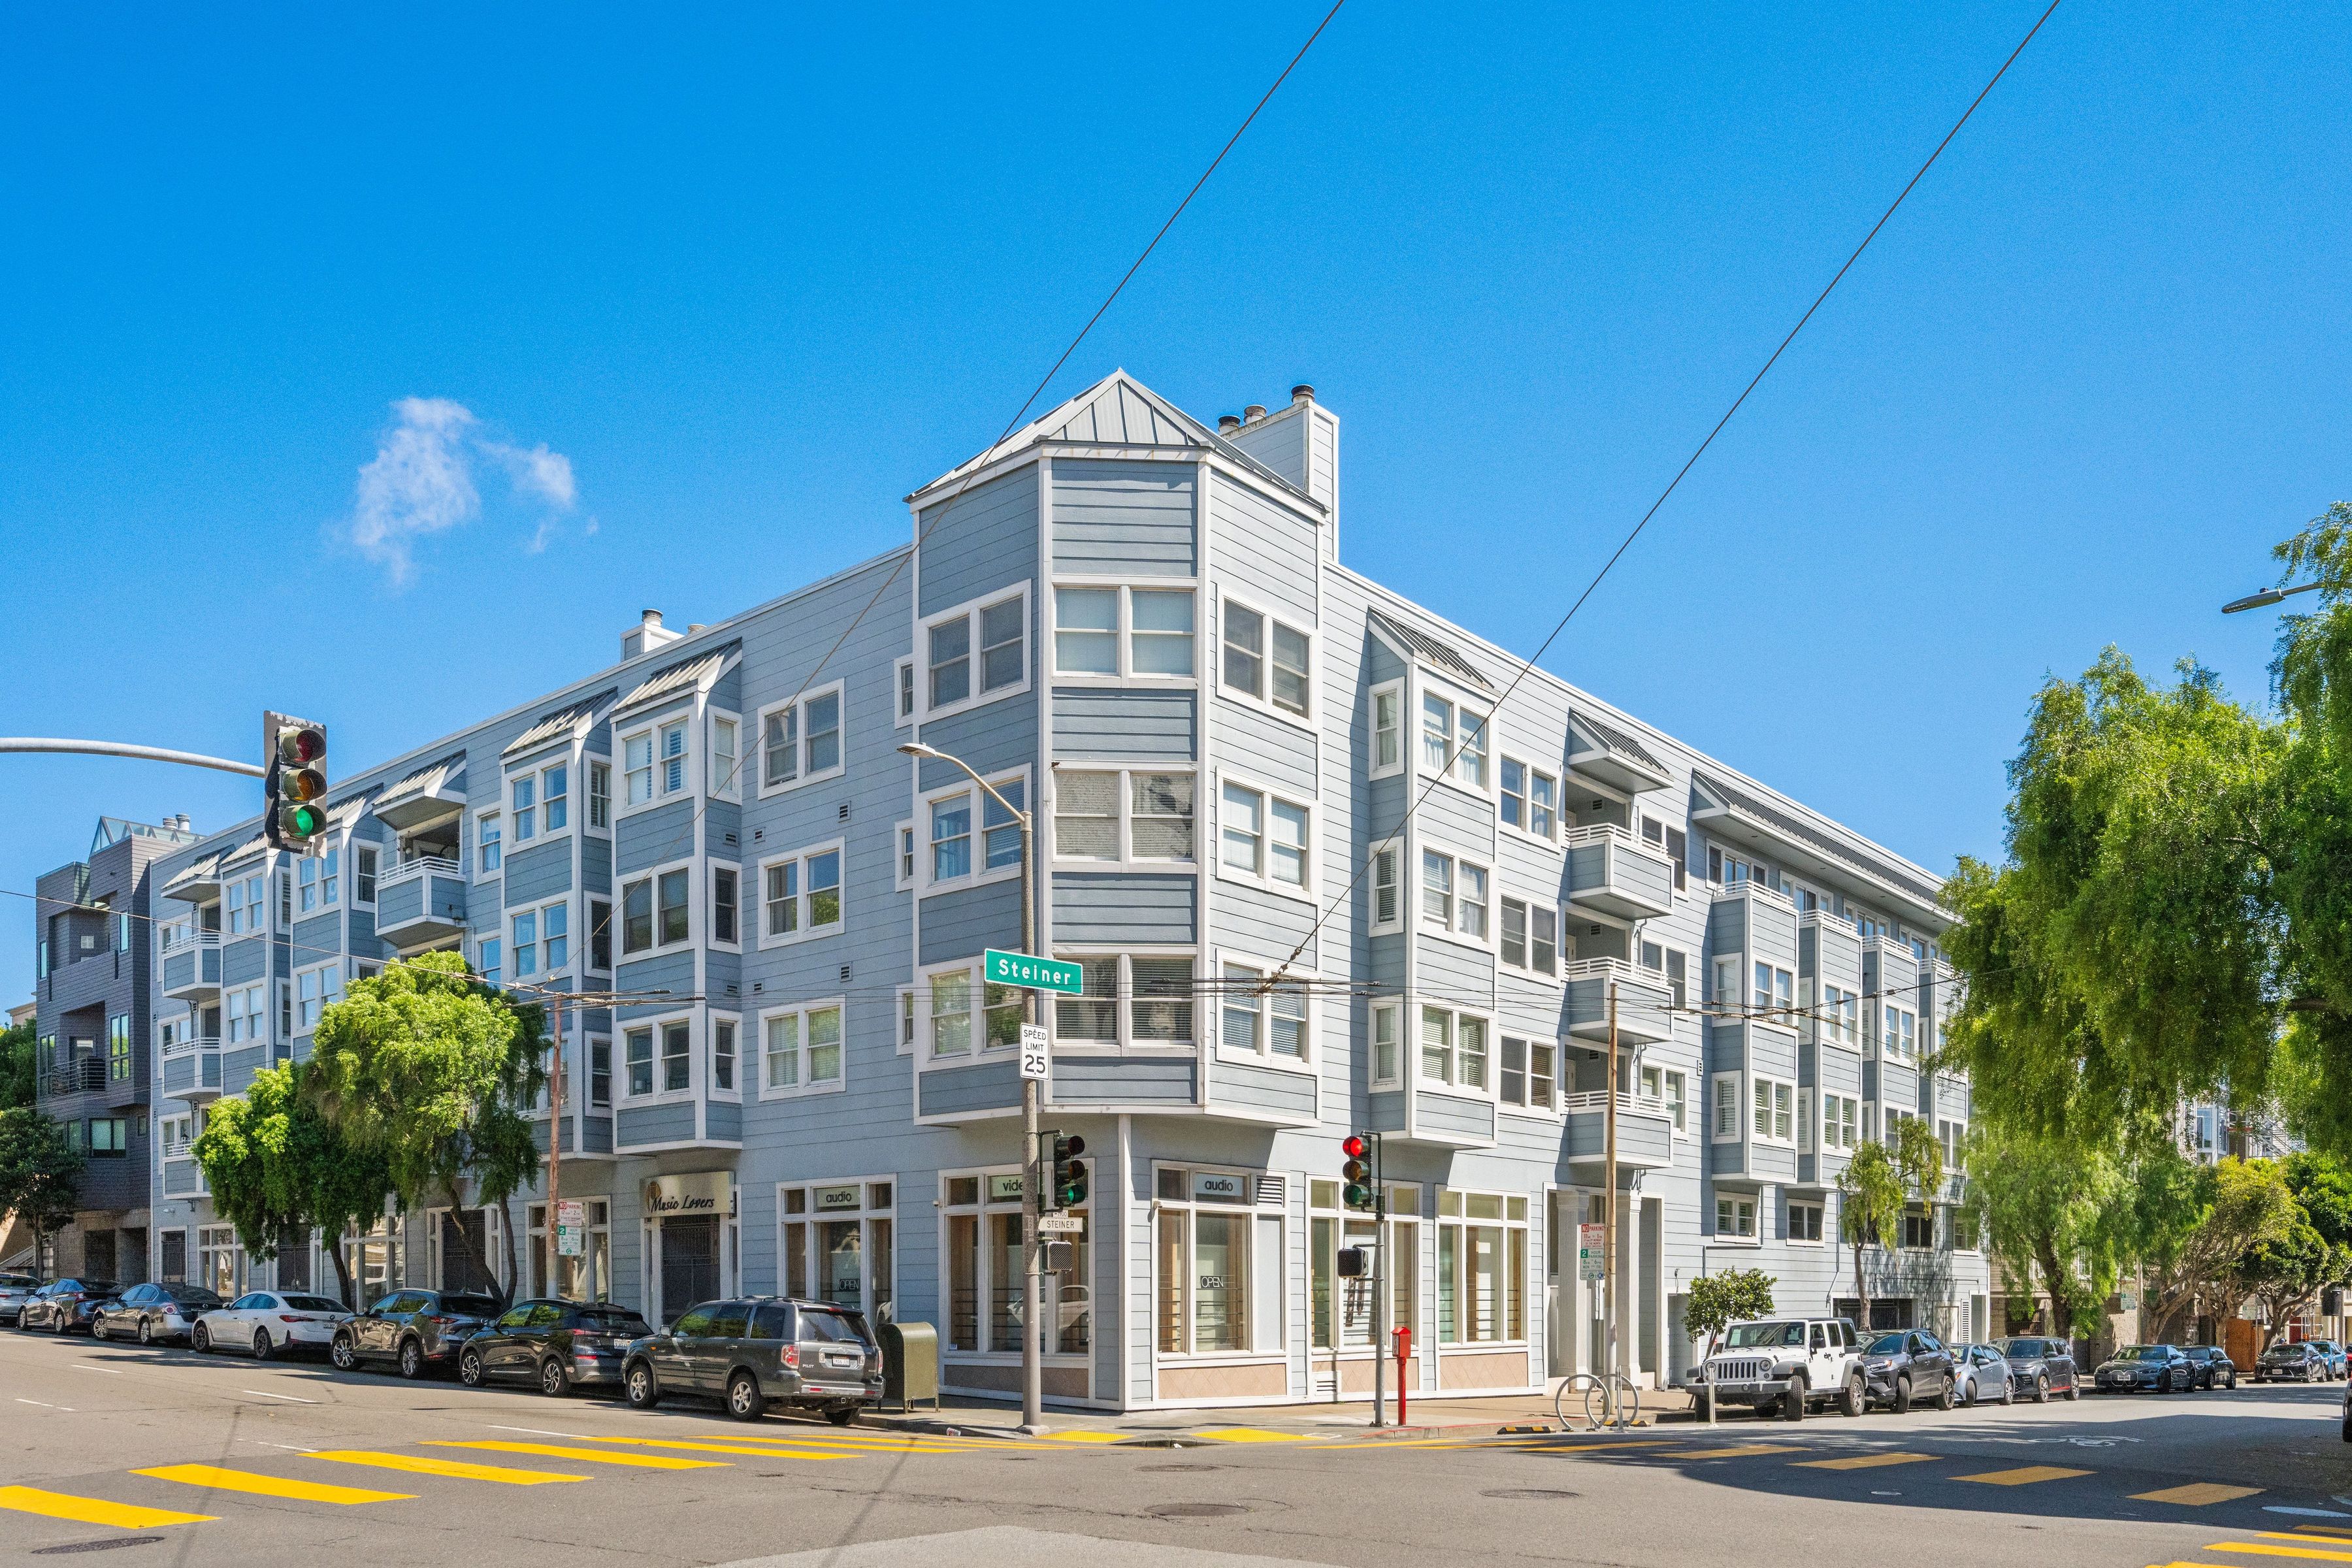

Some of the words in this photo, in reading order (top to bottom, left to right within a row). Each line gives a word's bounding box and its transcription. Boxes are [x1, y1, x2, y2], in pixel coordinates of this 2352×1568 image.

[998, 959, 1071, 985] Steiner
[1024, 1029, 1047, 1040] SPEED
[1026, 1042, 1044, 1052] LIMIT
[1024, 1054, 1045, 1073] 25
[1003, 1179, 1023, 1191] vide
[1205, 1179, 1233, 1191] audio
[826, 1191, 852, 1202] audio
[651, 1196, 679, 1213] Music
[681, 1195, 715, 1209] Lovers
[840, 1280, 859, 1290] OPEN
[1201, 1277, 1224, 1288] OPEN
